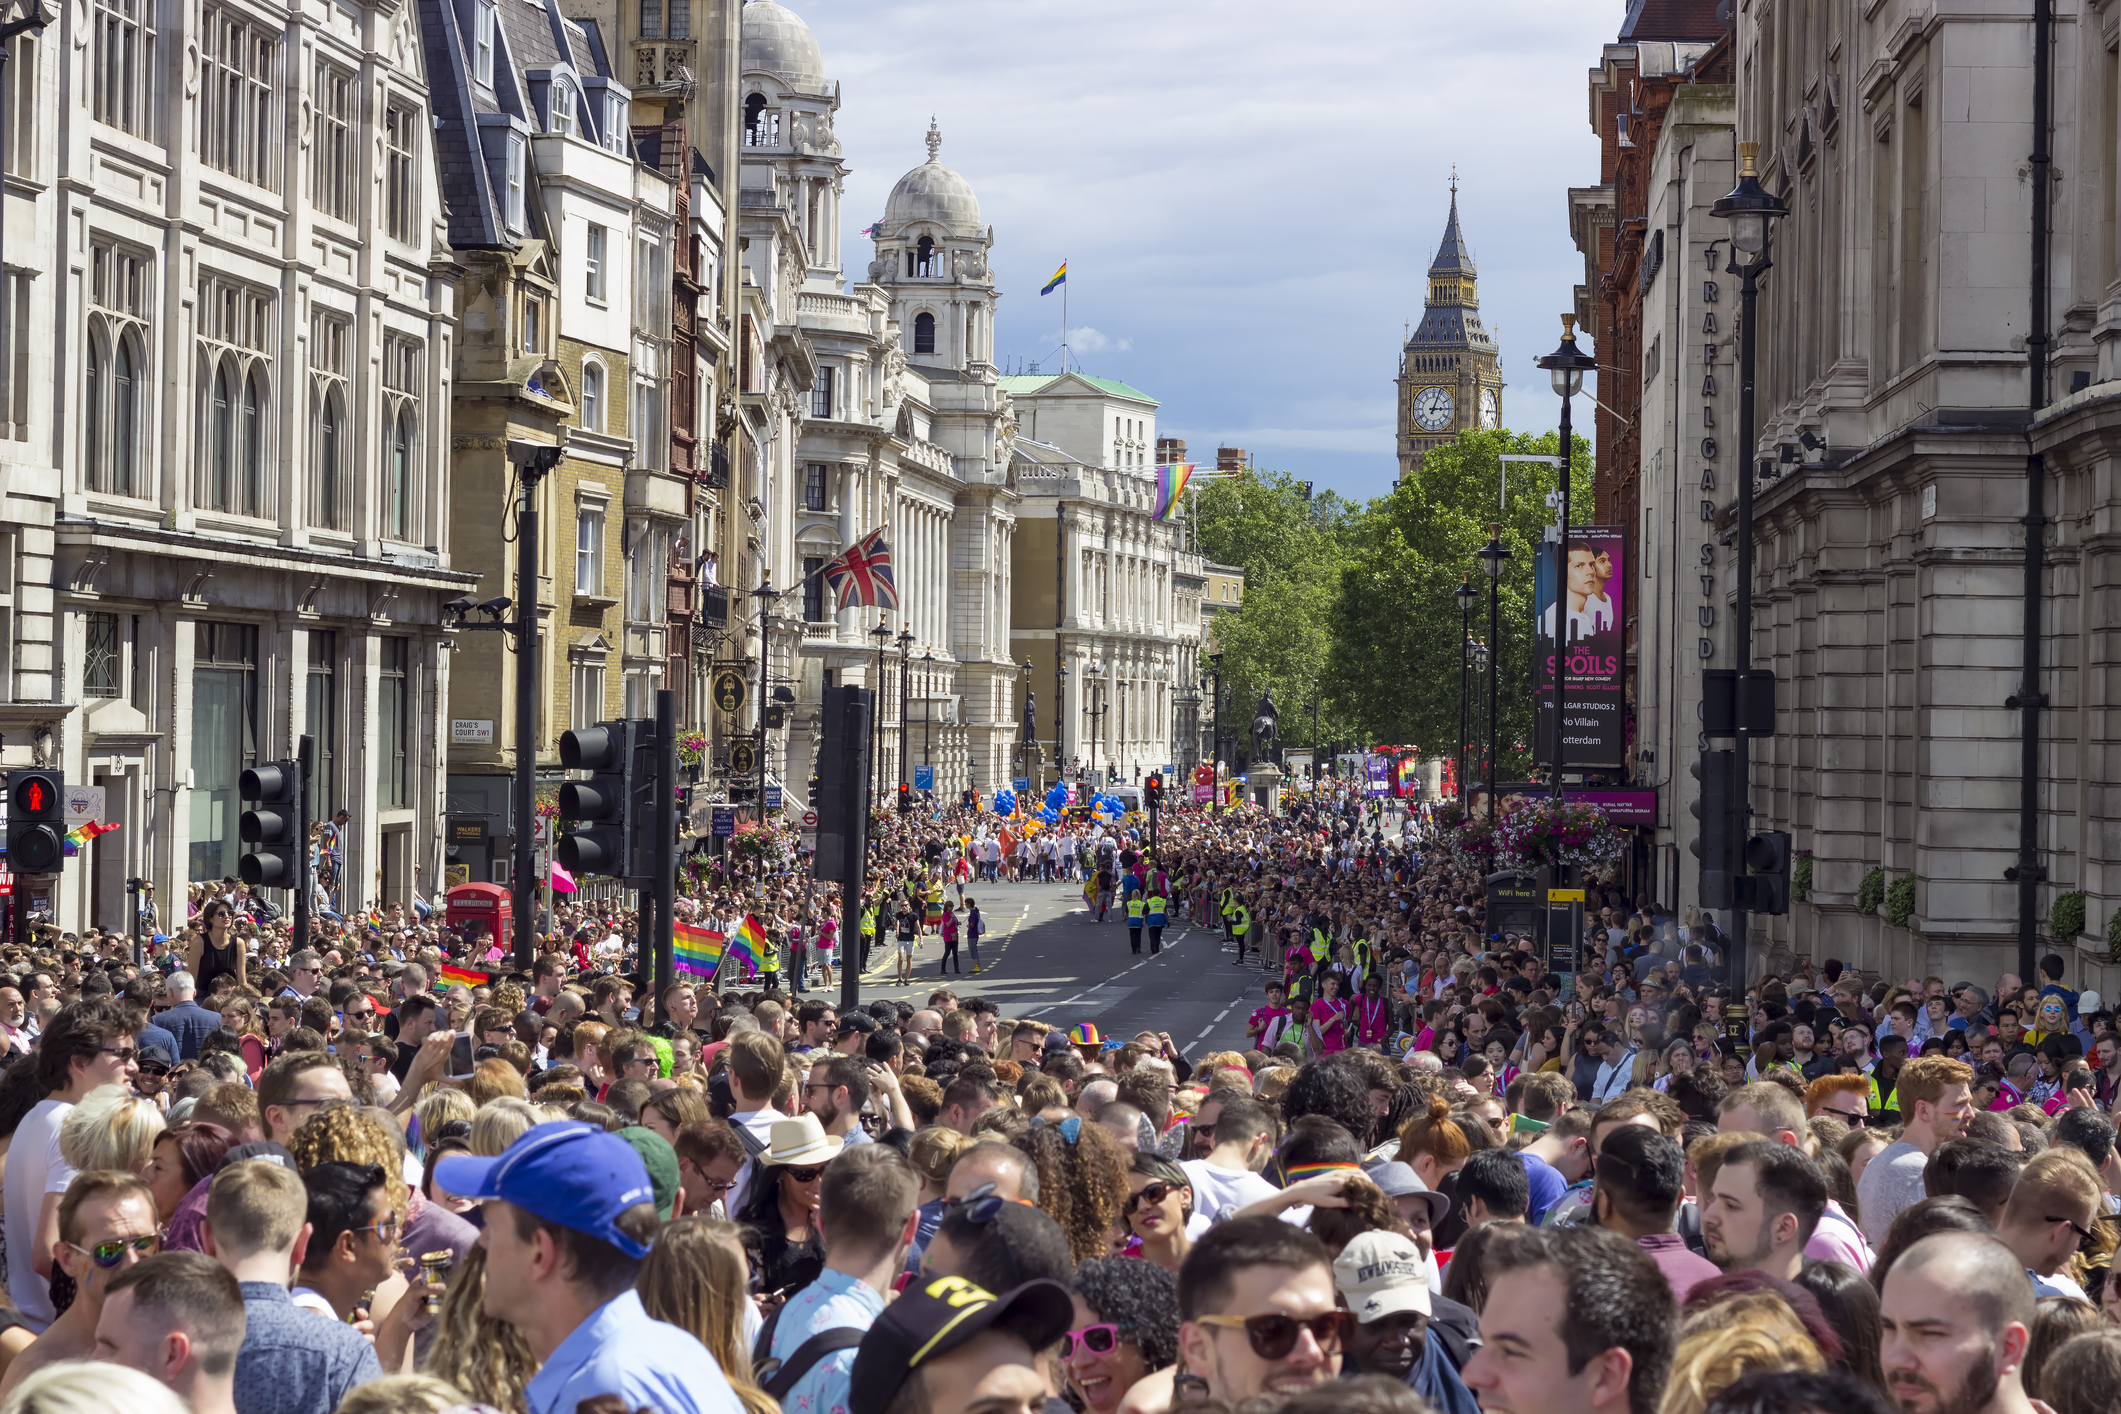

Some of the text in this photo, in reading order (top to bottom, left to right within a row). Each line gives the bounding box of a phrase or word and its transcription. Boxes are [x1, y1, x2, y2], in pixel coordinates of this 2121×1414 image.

[1700, 249, 1719, 522] TRAFALGAR
[1573, 646, 1590, 655] THE
[1582, 702, 1610, 710] STUDIOS
[1611, 703, 1616, 711] 2
[455, 721, 478, 729] CRAIG'S
[1574, 717, 1599, 727] Villain
[1562, 735, 1601, 745] otterdam
[1515, 889, 1530, 897] here
[1357, 1264, 1374, 1284] NEW
